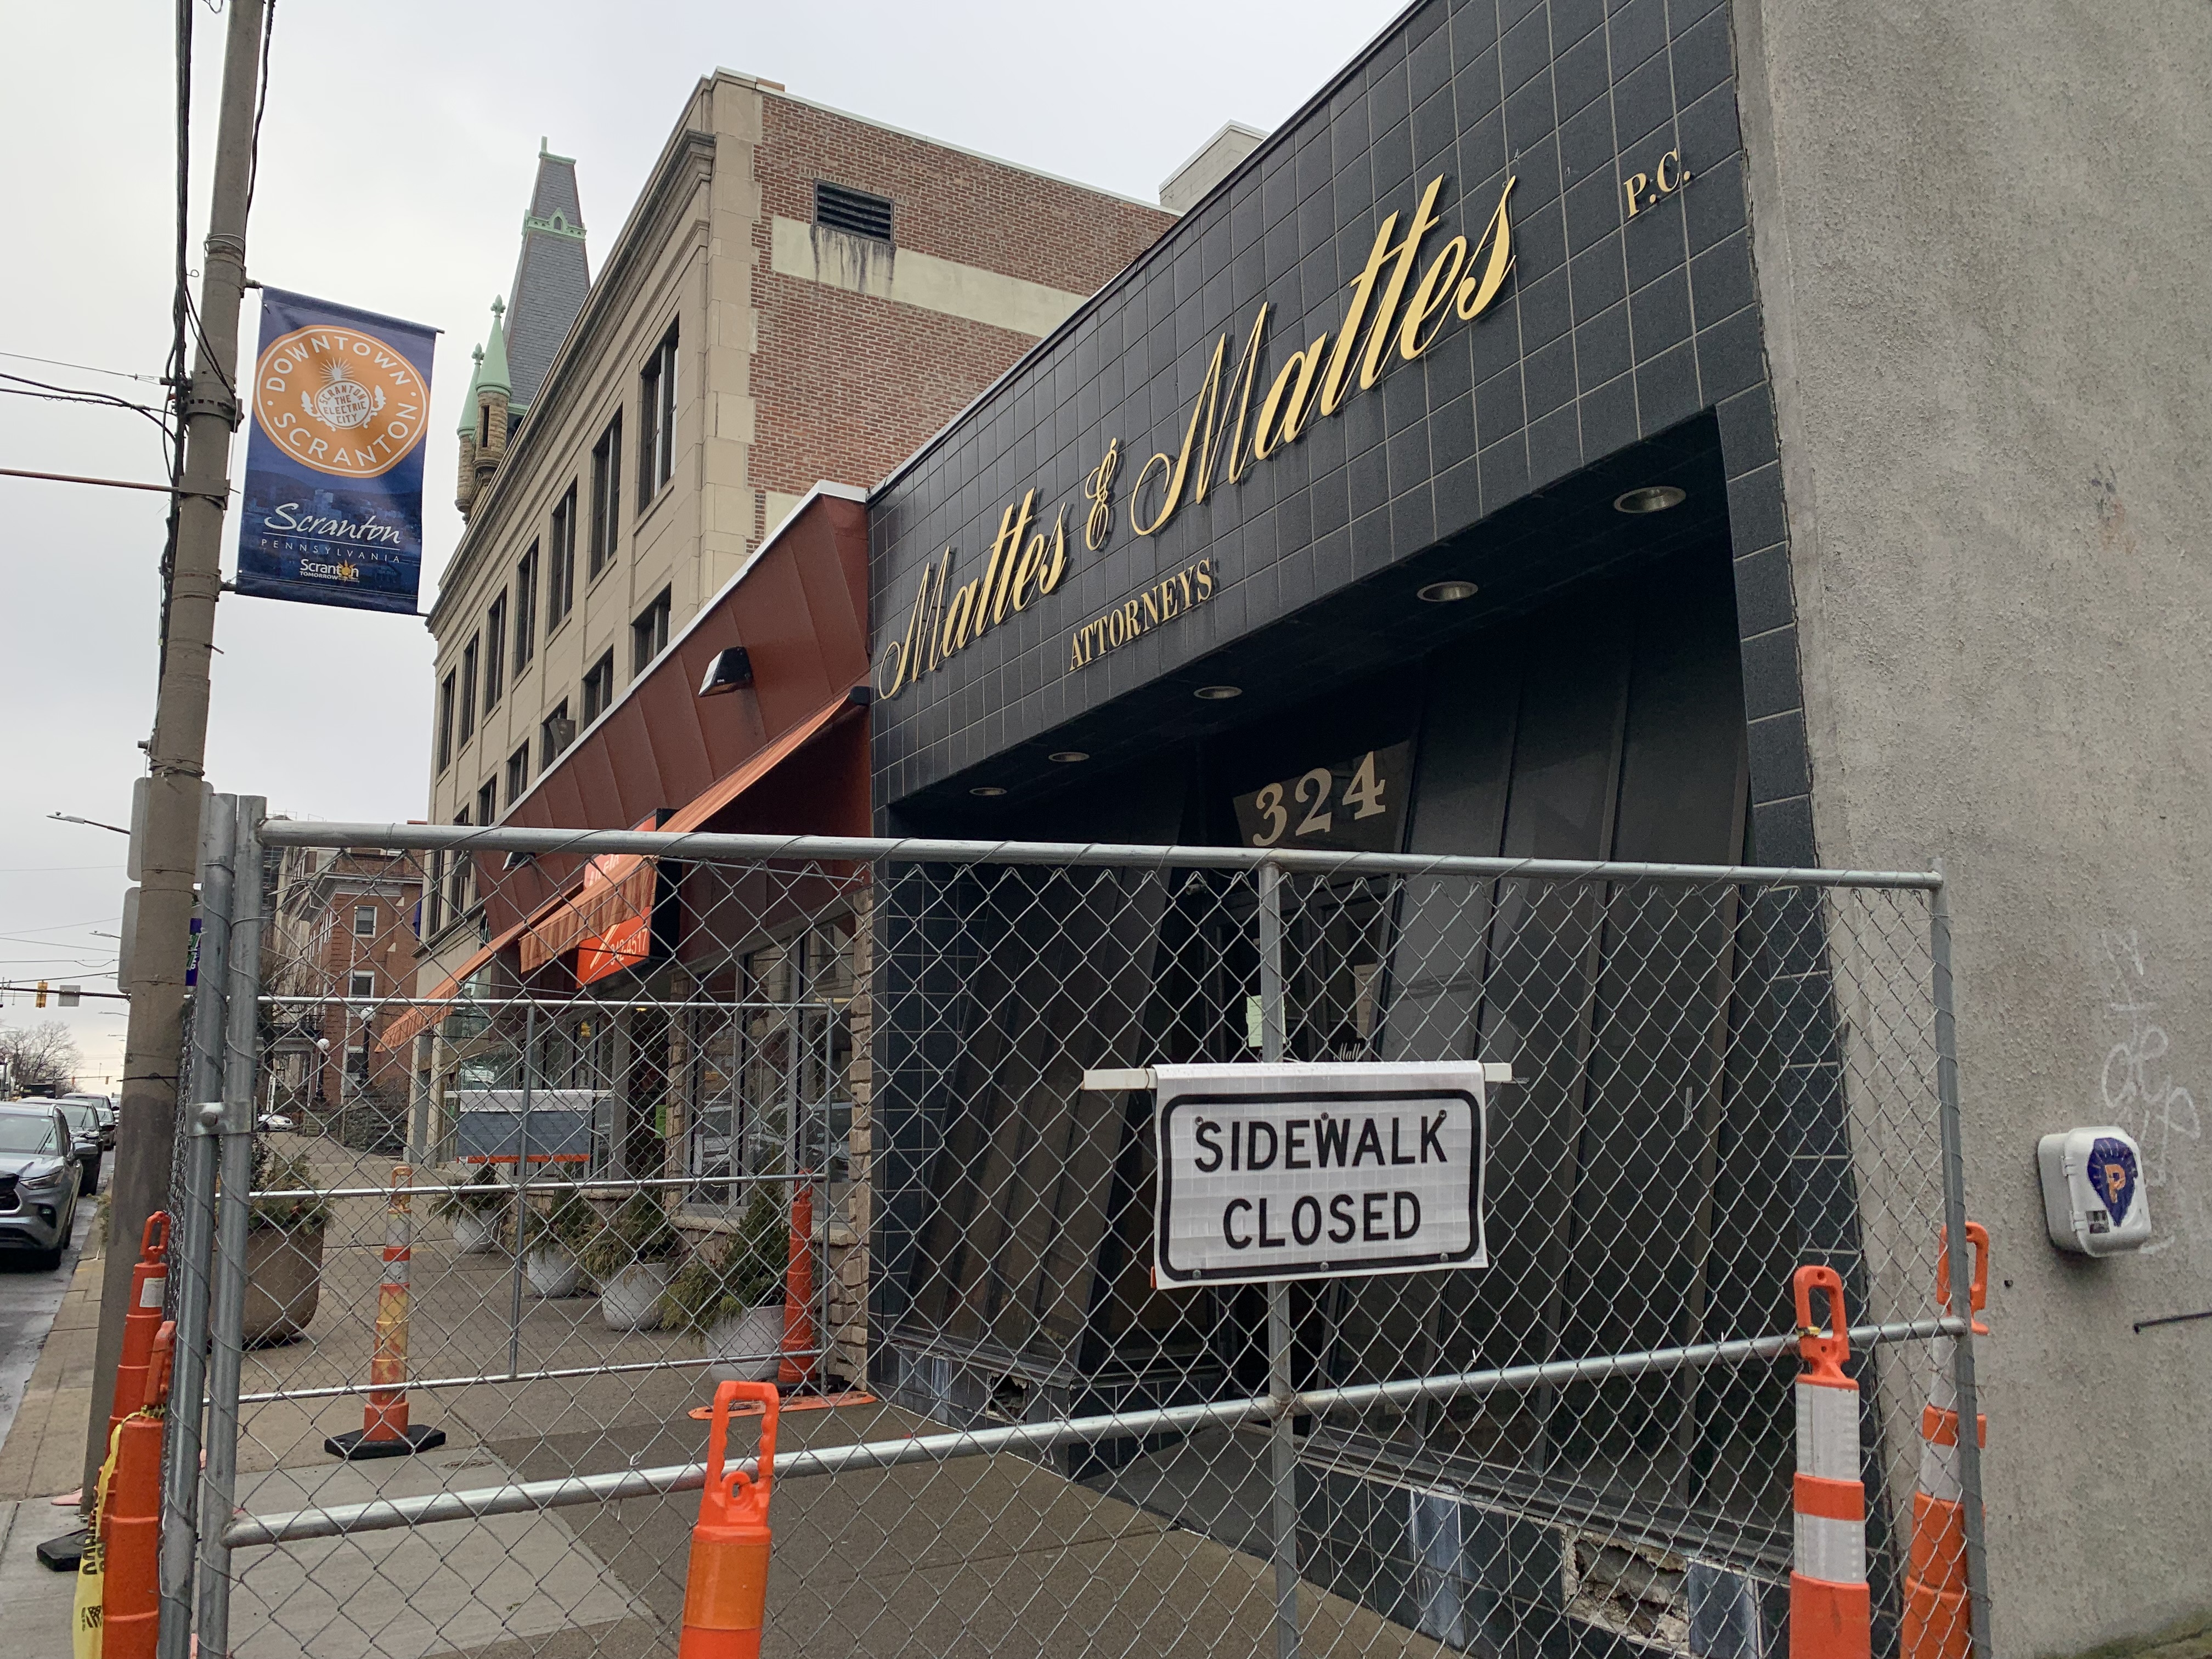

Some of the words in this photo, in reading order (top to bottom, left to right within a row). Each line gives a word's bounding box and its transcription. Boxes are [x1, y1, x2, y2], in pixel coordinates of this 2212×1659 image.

[266, 335, 410, 392] DOWNTOWN
[319, 385, 366, 405] SCRANTON
[323, 402, 366, 415] ELECTRIC
[334, 395, 351, 405] THE
[336, 413, 357, 424] CITY
[274, 402, 417, 467] SCRANTON
[879, 486, 1066, 699] Mattes
[1085, 437, 1117, 551] &
[1131, 173, 1517, 535] Mattes
[1623, 149, 1691, 219] P.C.
[264, 503, 401, 544] Scranton
[261, 538, 400, 563] PENNSYLVANIA
[299, 571, 338, 580] TOMORROW
[1069, 557, 1214, 671] ATTORNEYS
[1252, 751, 1386, 847] 324
[1194, 1113, 1448, 1173] SIDEWALK
[1223, 1191, 1421, 1250] CLOSED
